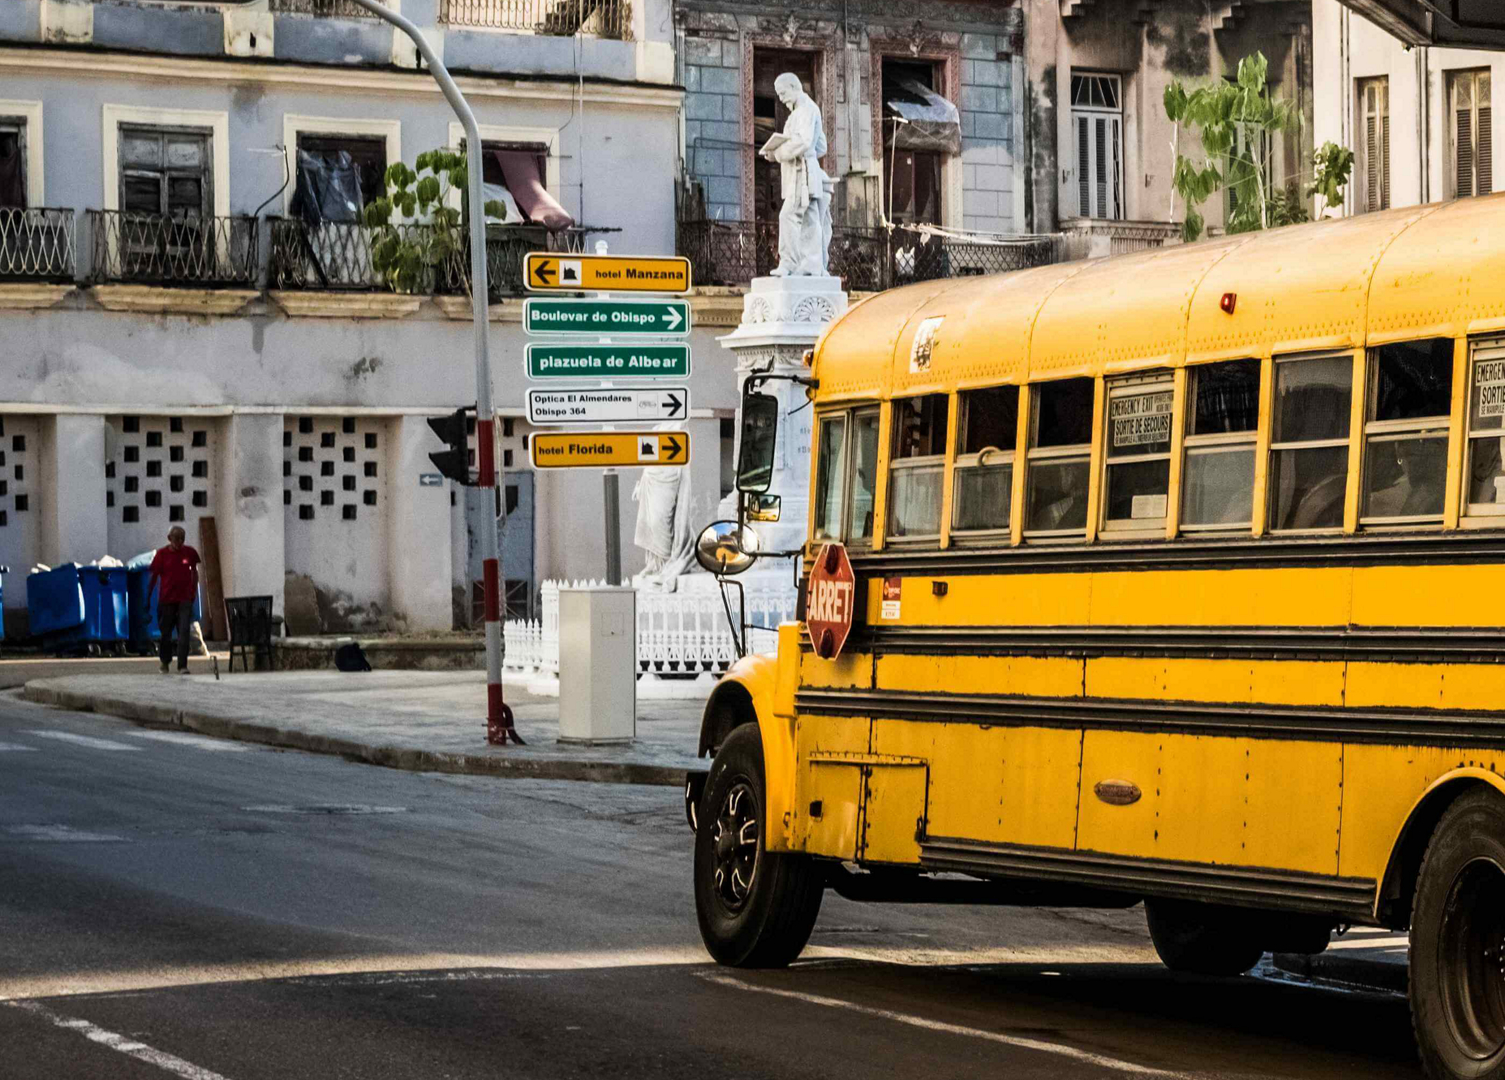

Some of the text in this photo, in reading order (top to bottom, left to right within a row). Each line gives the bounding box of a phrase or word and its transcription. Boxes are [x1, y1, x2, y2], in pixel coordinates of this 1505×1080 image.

[595, 269, 683, 280] hotel Manzana
[531, 310, 655, 325] Boulevar de Obispo
[540, 356, 601, 370] plazuela
[606, 356, 623, 367] de
[534, 395, 565, 404] Optica
[579, 394, 632, 403] Almendares
[1481, 384, 1505, 405] SORTIE
[535, 407, 586, 416] Obispo 364
[538, 444, 613, 455] hotel Florida
[808, 580, 852, 624] ARRET
